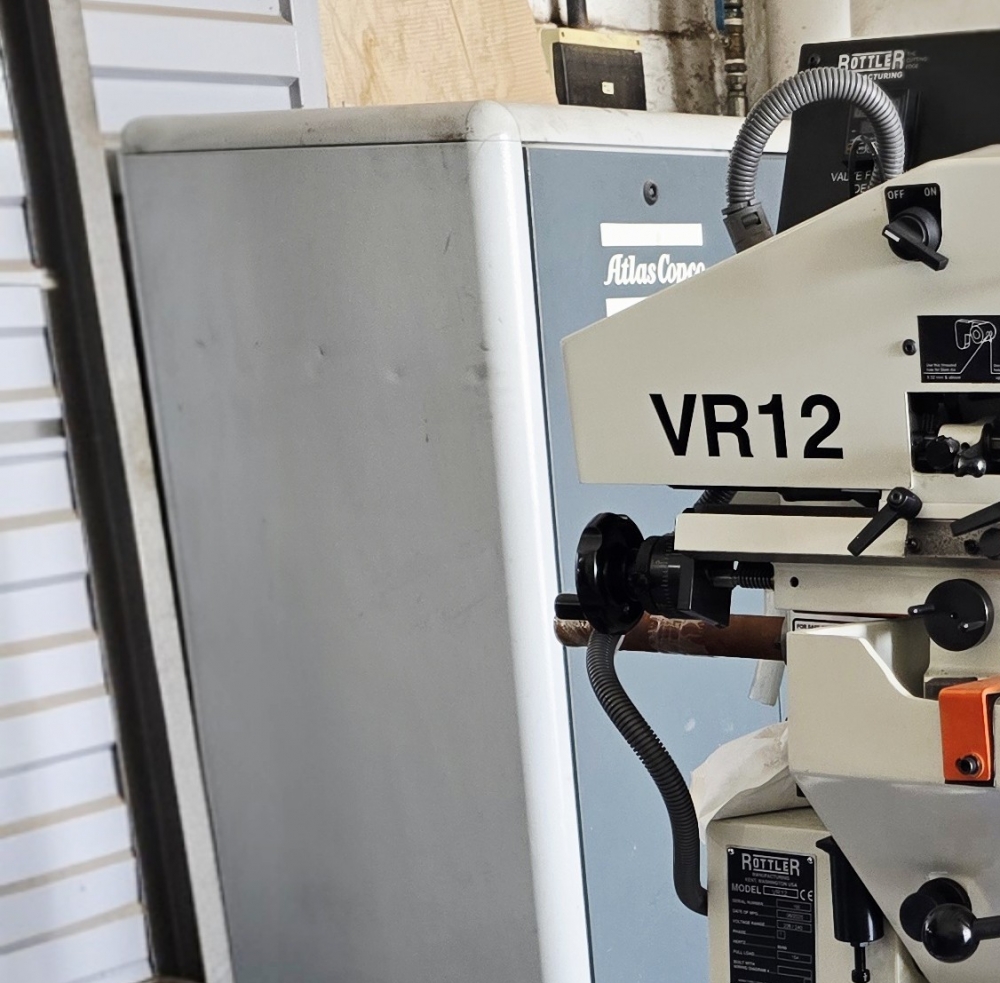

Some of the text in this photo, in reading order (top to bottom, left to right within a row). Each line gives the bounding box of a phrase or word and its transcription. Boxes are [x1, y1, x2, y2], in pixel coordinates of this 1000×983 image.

[838, 50, 905, 71] ROTTLER
[831, 172, 862, 182] VALE
[887, 187, 937, 200] OFF ON
[603, 253, 657, 286] Atlas
[649, 394, 844, 460] VR12
[741, 853, 800, 876] ROTTLER
[731, 883, 762, 895] MODEL
